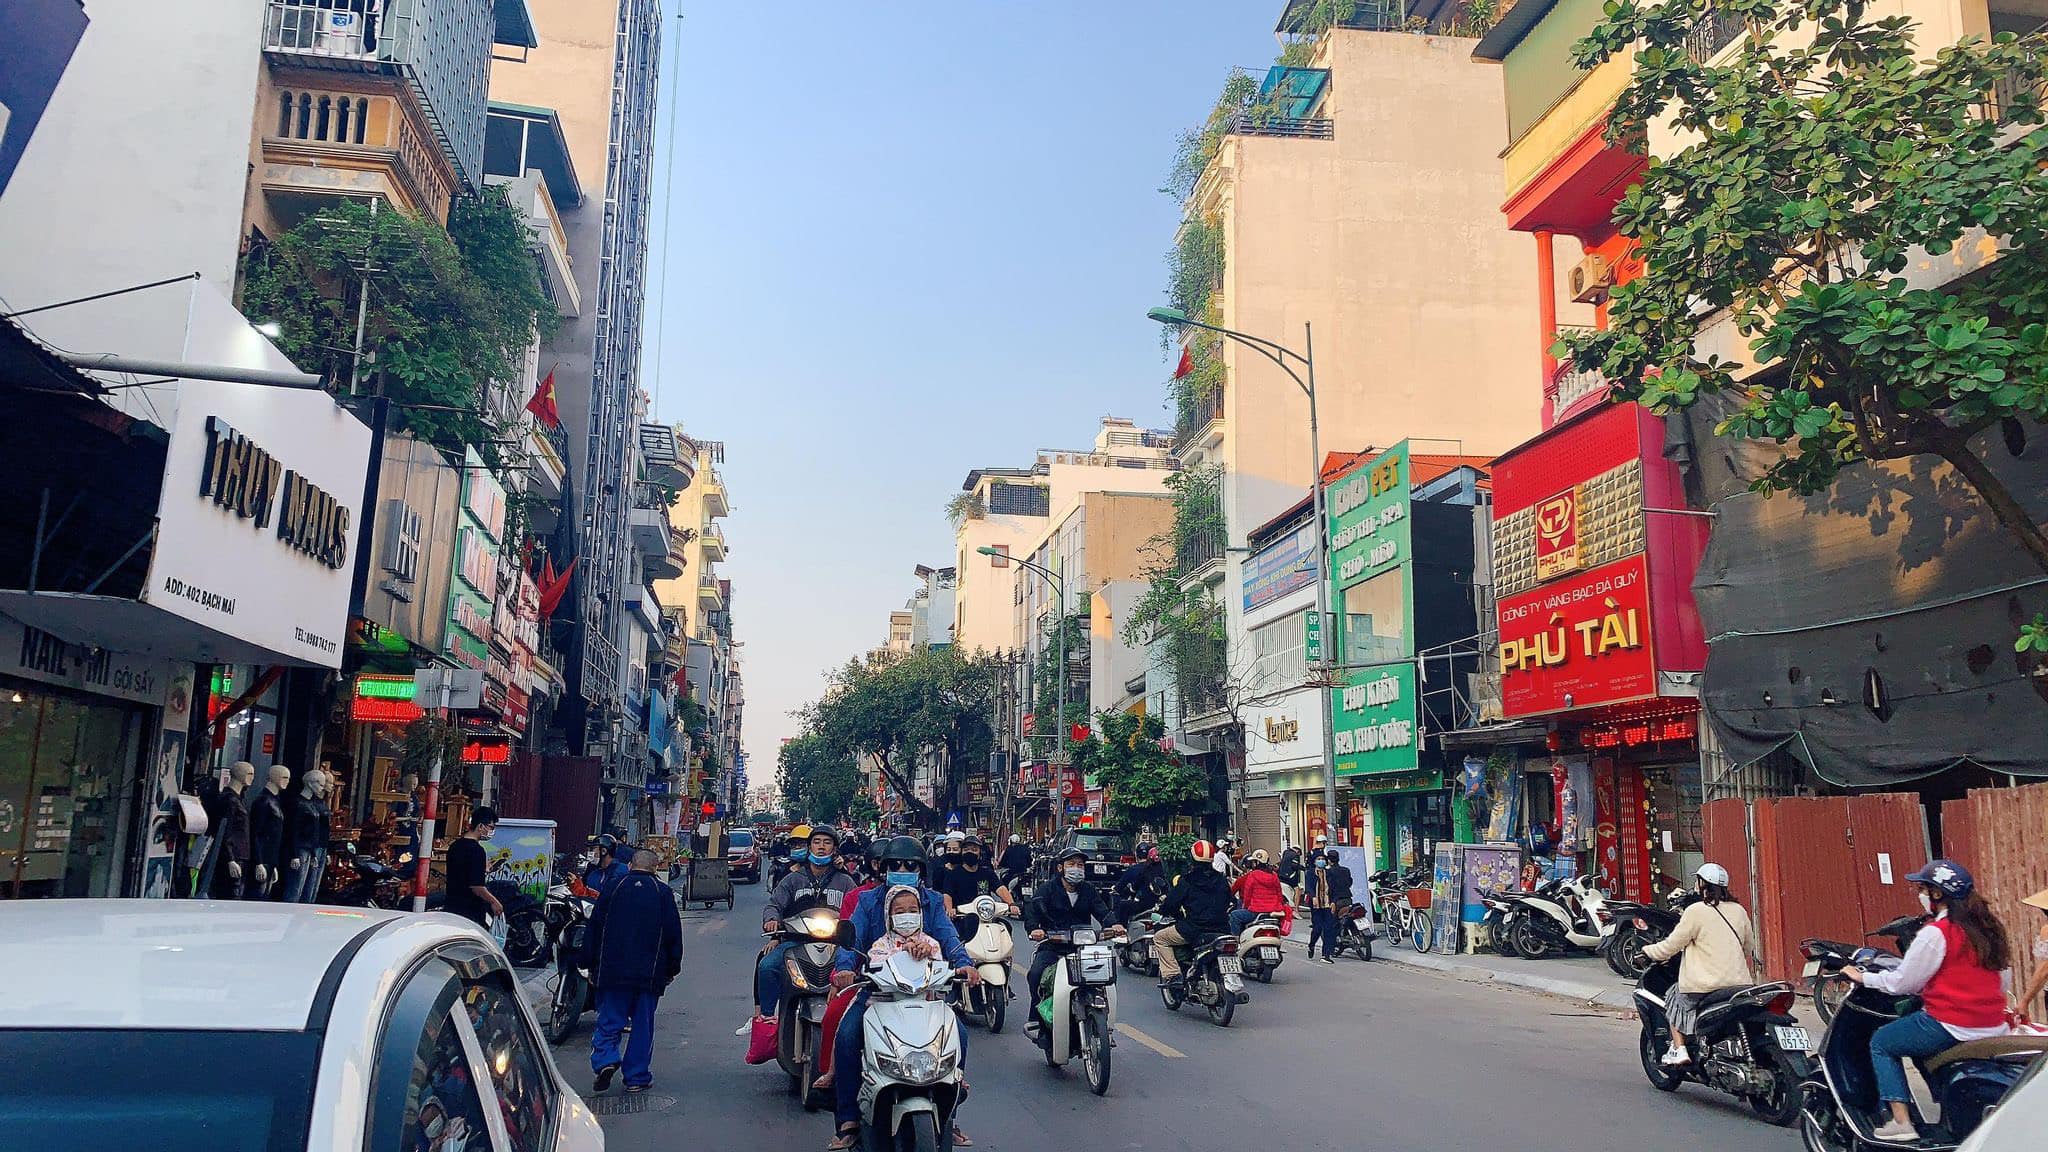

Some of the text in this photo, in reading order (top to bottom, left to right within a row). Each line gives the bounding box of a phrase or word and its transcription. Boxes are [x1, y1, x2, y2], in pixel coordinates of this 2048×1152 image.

[1370, 454, 1400, 498] PET
[277, 469, 350, 570] NAILS
[1380, 500, 1405, 527] SPA
[201, 591, 221, 611] BẠCH
[1529, 601, 1541, 613] TY
[1545, 593, 1571, 608] VÀNG
[1572, 585, 1594, 602] BẠC
[1308, 614, 1320, 625] SP
[1500, 597, 1640, 675] PHÚ TÀI
[19, 625, 67, 676] NAIL
[1264, 715, 1298, 744] Venice
[1335, 730, 1354, 755] SPA
